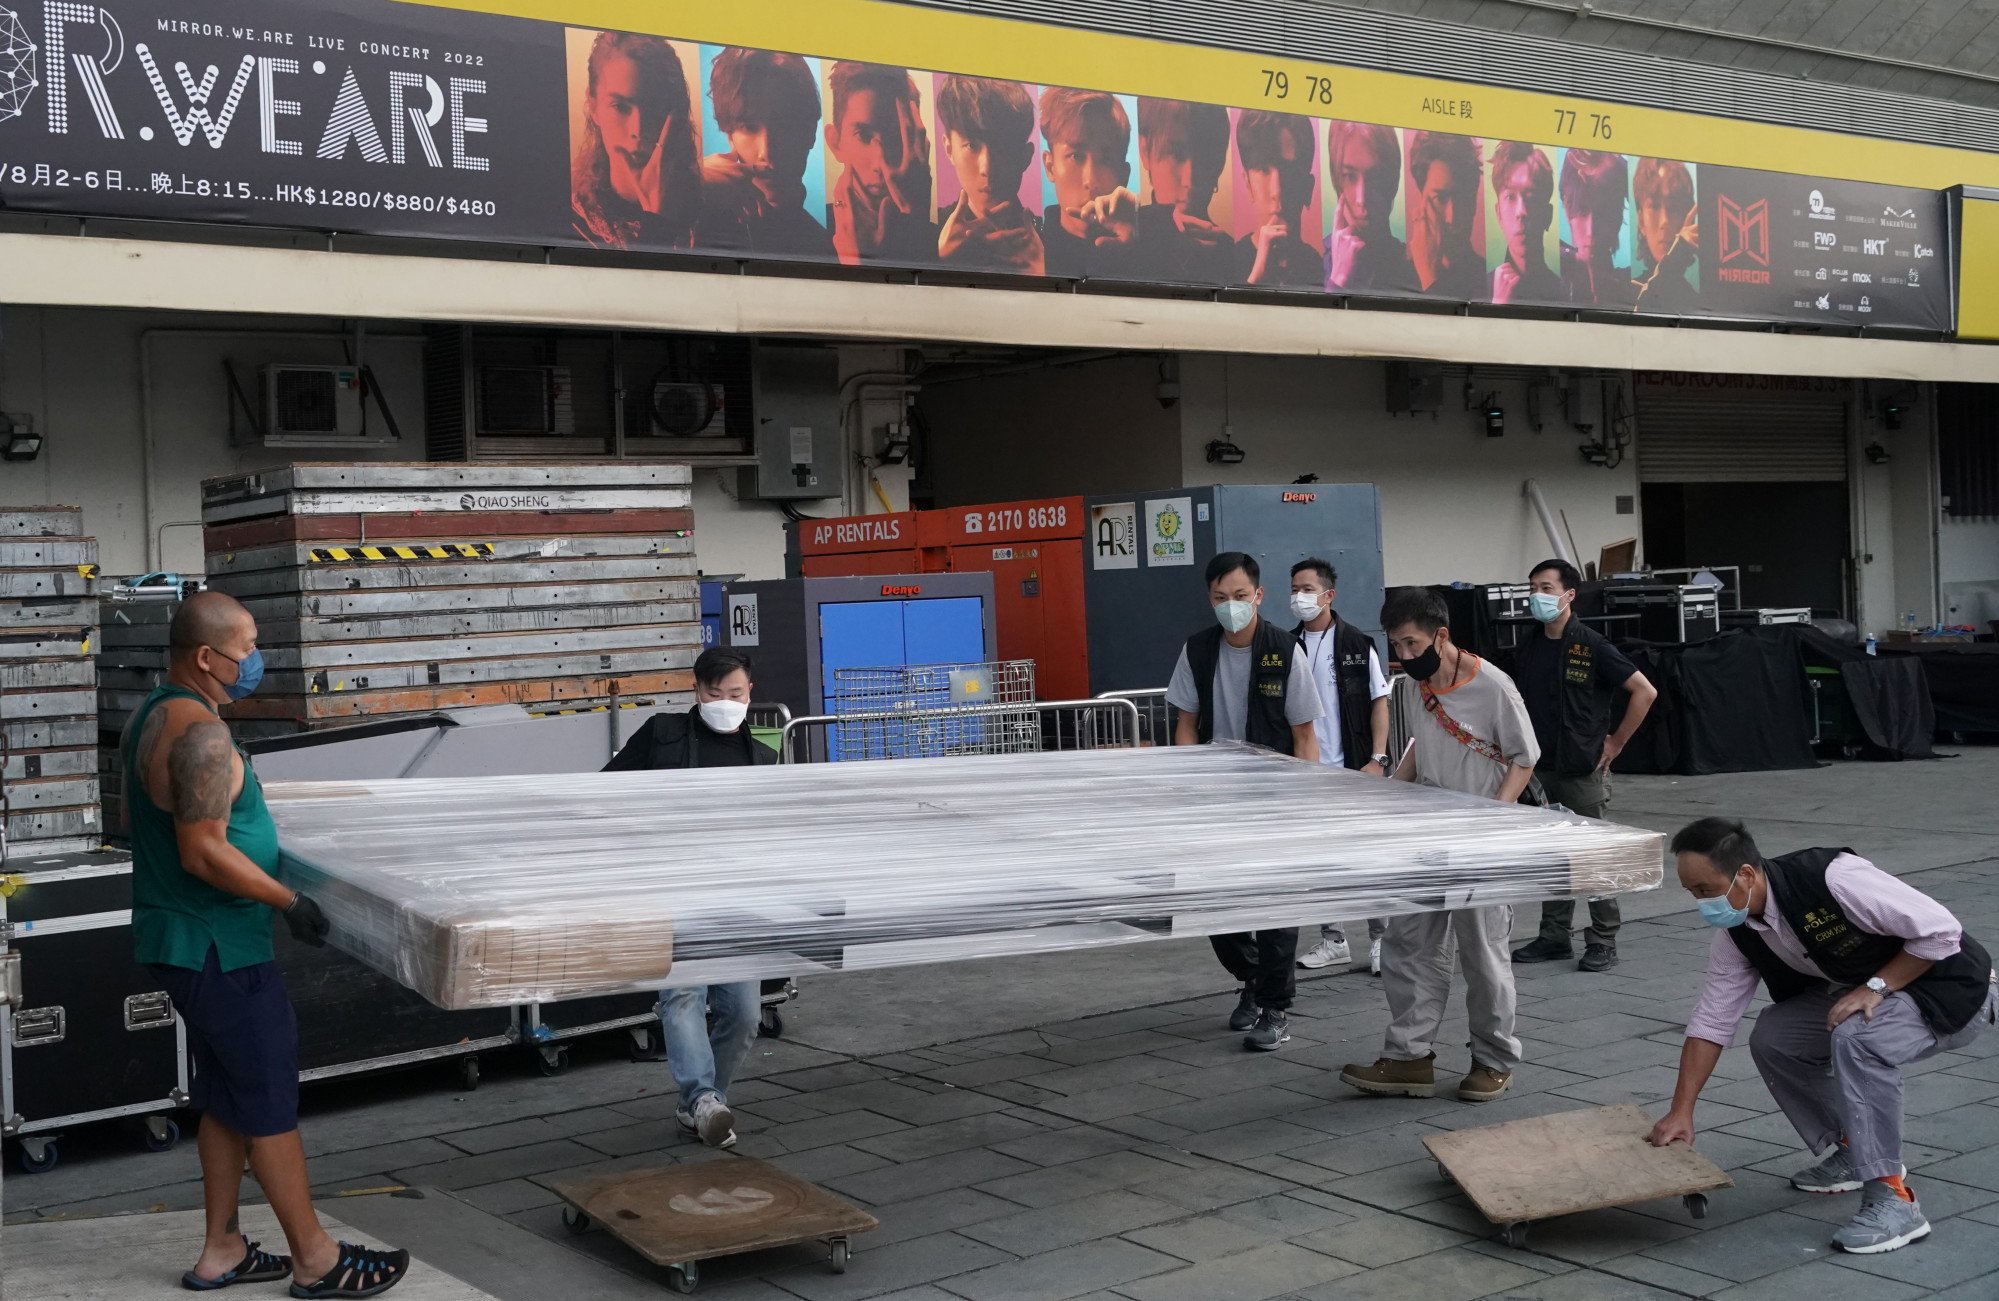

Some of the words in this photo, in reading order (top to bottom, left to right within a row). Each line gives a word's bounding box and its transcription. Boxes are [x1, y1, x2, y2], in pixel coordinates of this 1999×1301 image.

[157, 18, 294, 45] MIRROR.WE.ARE
[308, 35, 345, 51] LIVE
[359, 41, 430, 61] CONCERT
[444, 52, 484, 67] 2022
[1261, 69, 1289, 99] 79
[1305, 75, 1333, 105] 78
[1421, 97, 1456, 116] AISLE
[1460, 100, 1473, 119] 段
[1554, 109, 1577, 135] 77
[1590, 113, 1612, 140] 76
[1814, 231, 1836, 246] FWD
[1863, 238, 1886, 256] HKT
[477, 496, 509, 508] QIAO
[511, 495, 550, 508] SHENG
[1281, 491, 1318, 504] Denyo
[988, 509, 1022, 532] 2170
[1028, 505, 1067, 529] 8638
[814, 526, 833, 545] AP
[837, 519, 900, 543] RENTALS
[1127, 515, 1135, 555] RENTALS
[880, 584, 922, 597] Denyo
[1803, 913, 1838, 933] POLICE
